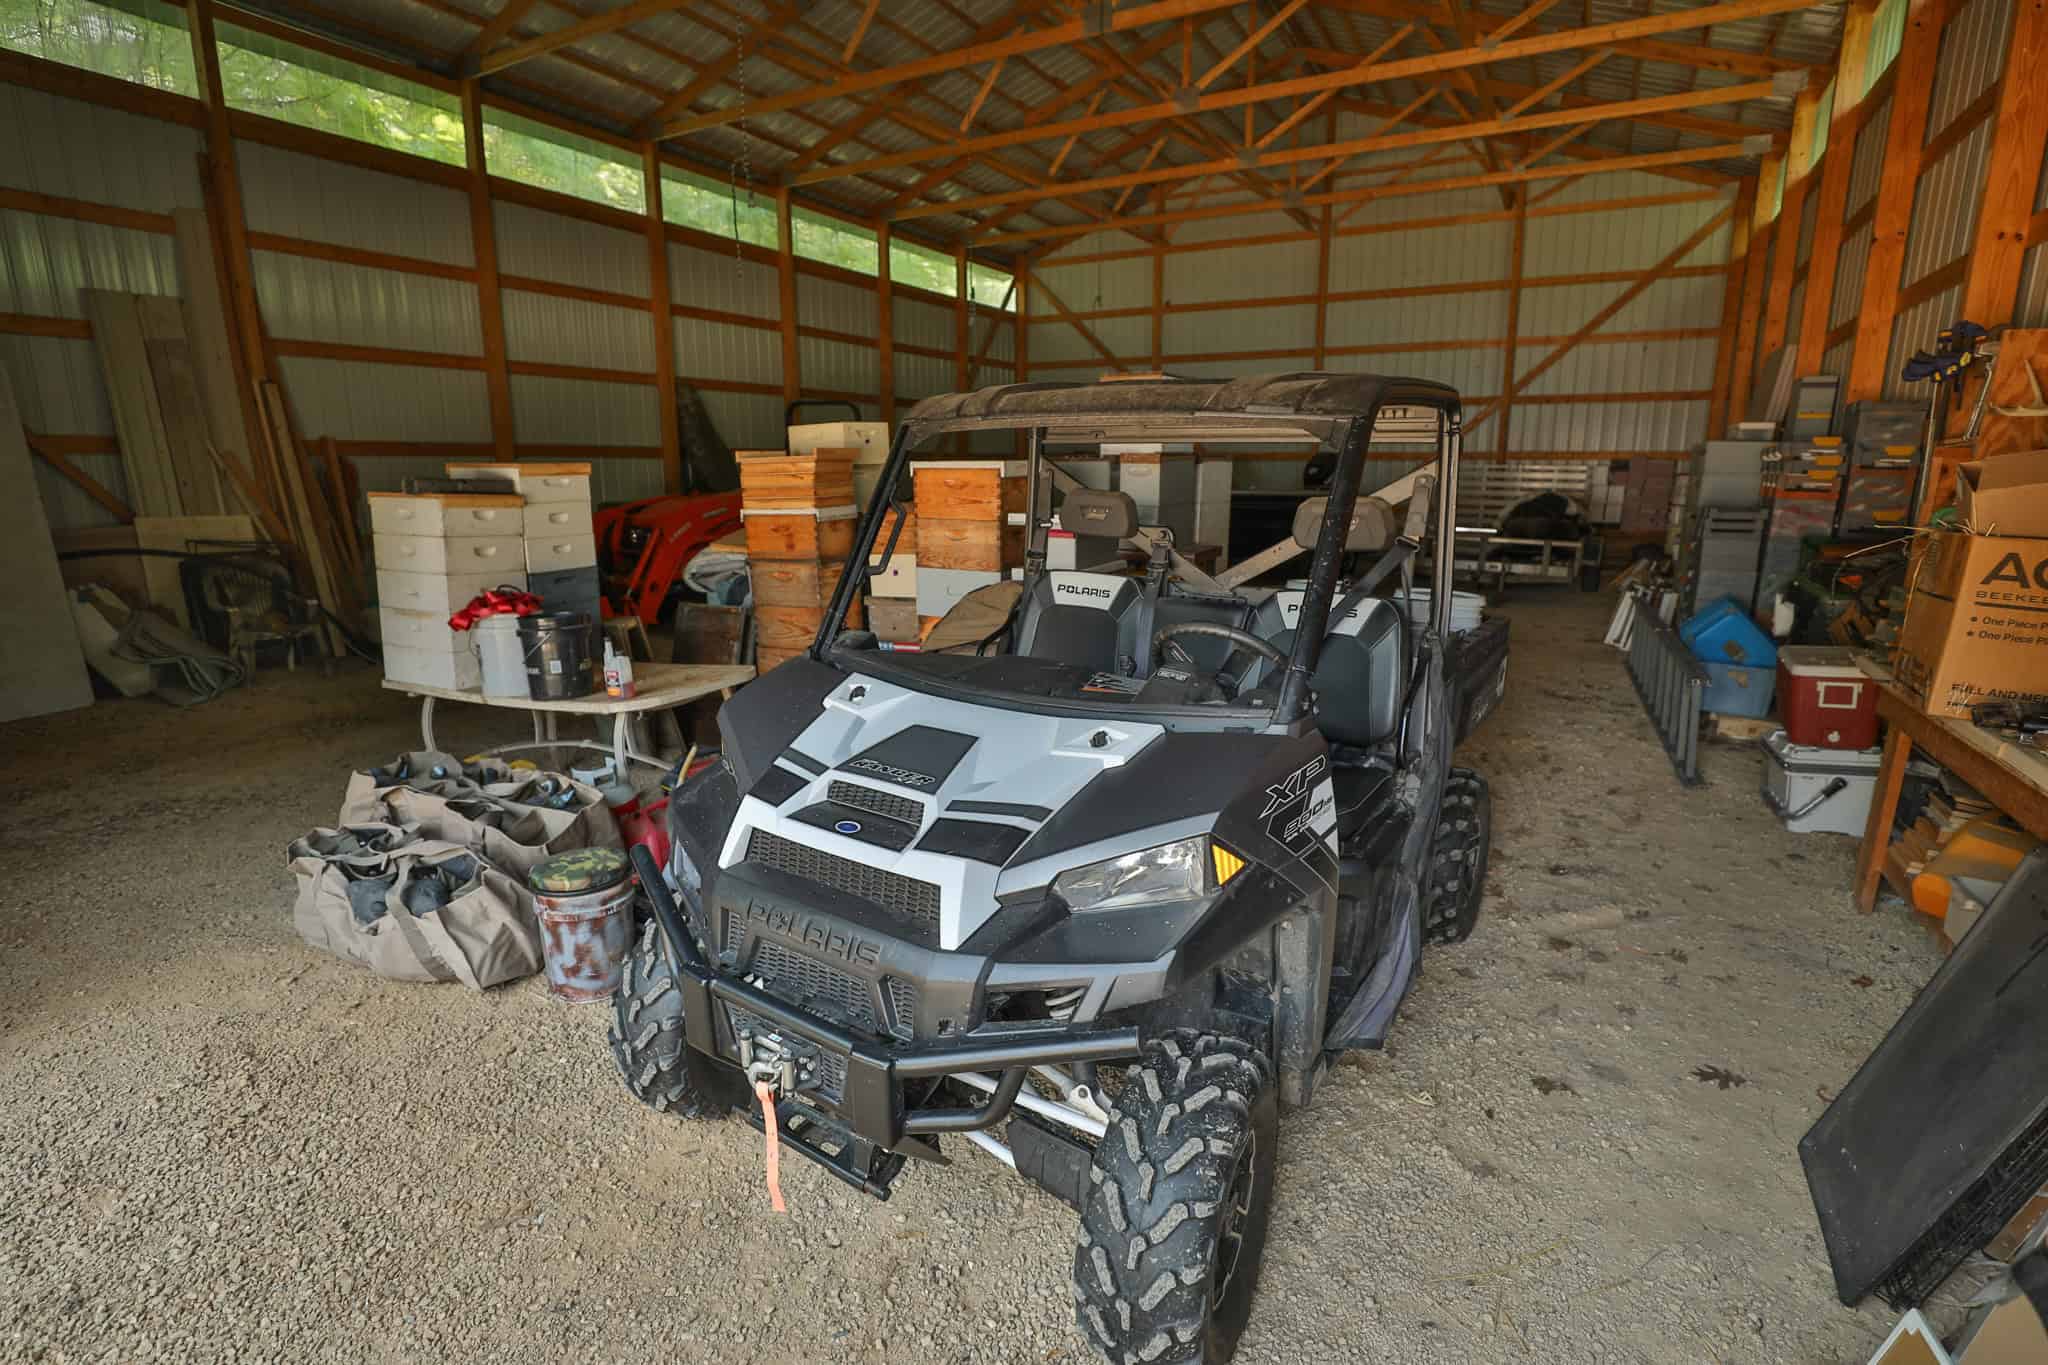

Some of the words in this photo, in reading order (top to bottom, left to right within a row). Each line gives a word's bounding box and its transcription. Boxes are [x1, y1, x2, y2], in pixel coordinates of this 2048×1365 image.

[1056, 583, 1112, 599] POLARIS
[1982, 615, 2005, 627] One
[2007, 618, 2037, 629] Piece
[1978, 630, 2001, 641] One
[2003, 632, 2033, 644] Piece
[1988, 688, 2017, 701] AND
[848, 758, 936, 786] RANGER
[1257, 753, 1326, 820] XP
[746, 897, 881, 966] POLARIS
